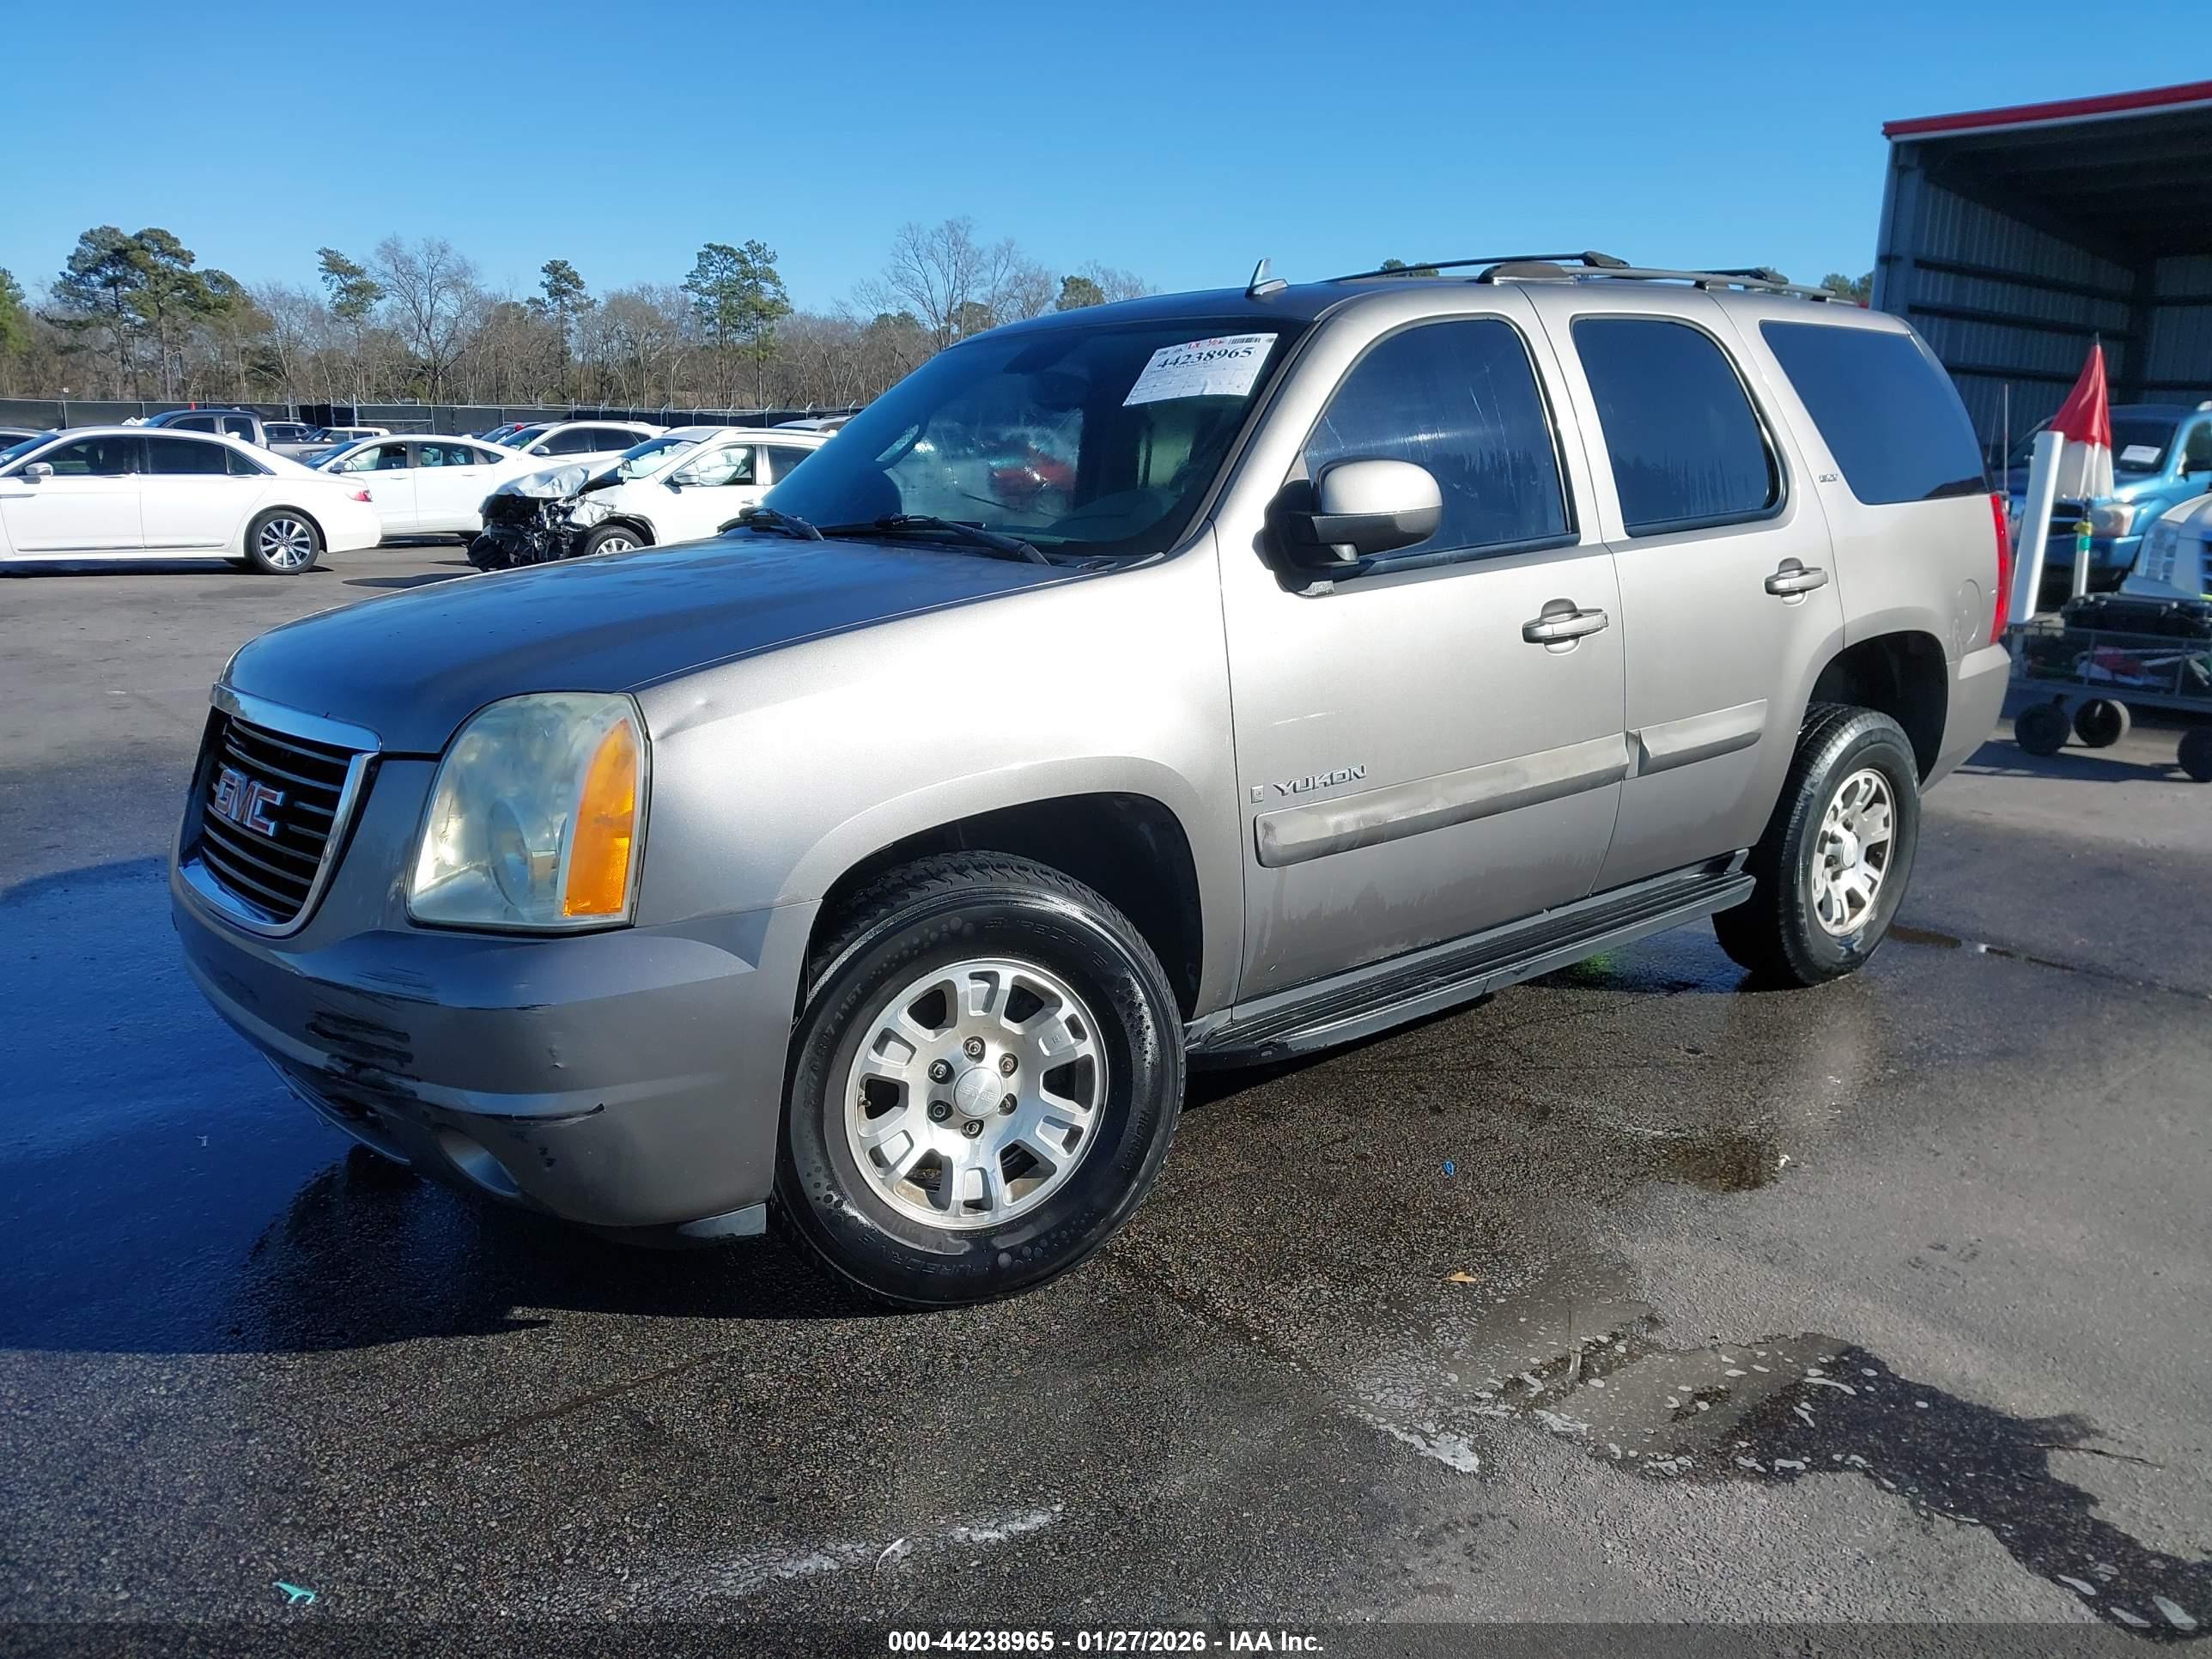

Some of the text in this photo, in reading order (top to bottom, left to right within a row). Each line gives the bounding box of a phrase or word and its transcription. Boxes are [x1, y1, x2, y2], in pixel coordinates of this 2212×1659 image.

[1157, 347, 1254, 369] 44238965
[1273, 763, 1367, 797] YUKON
[215, 769, 284, 837] GMC
